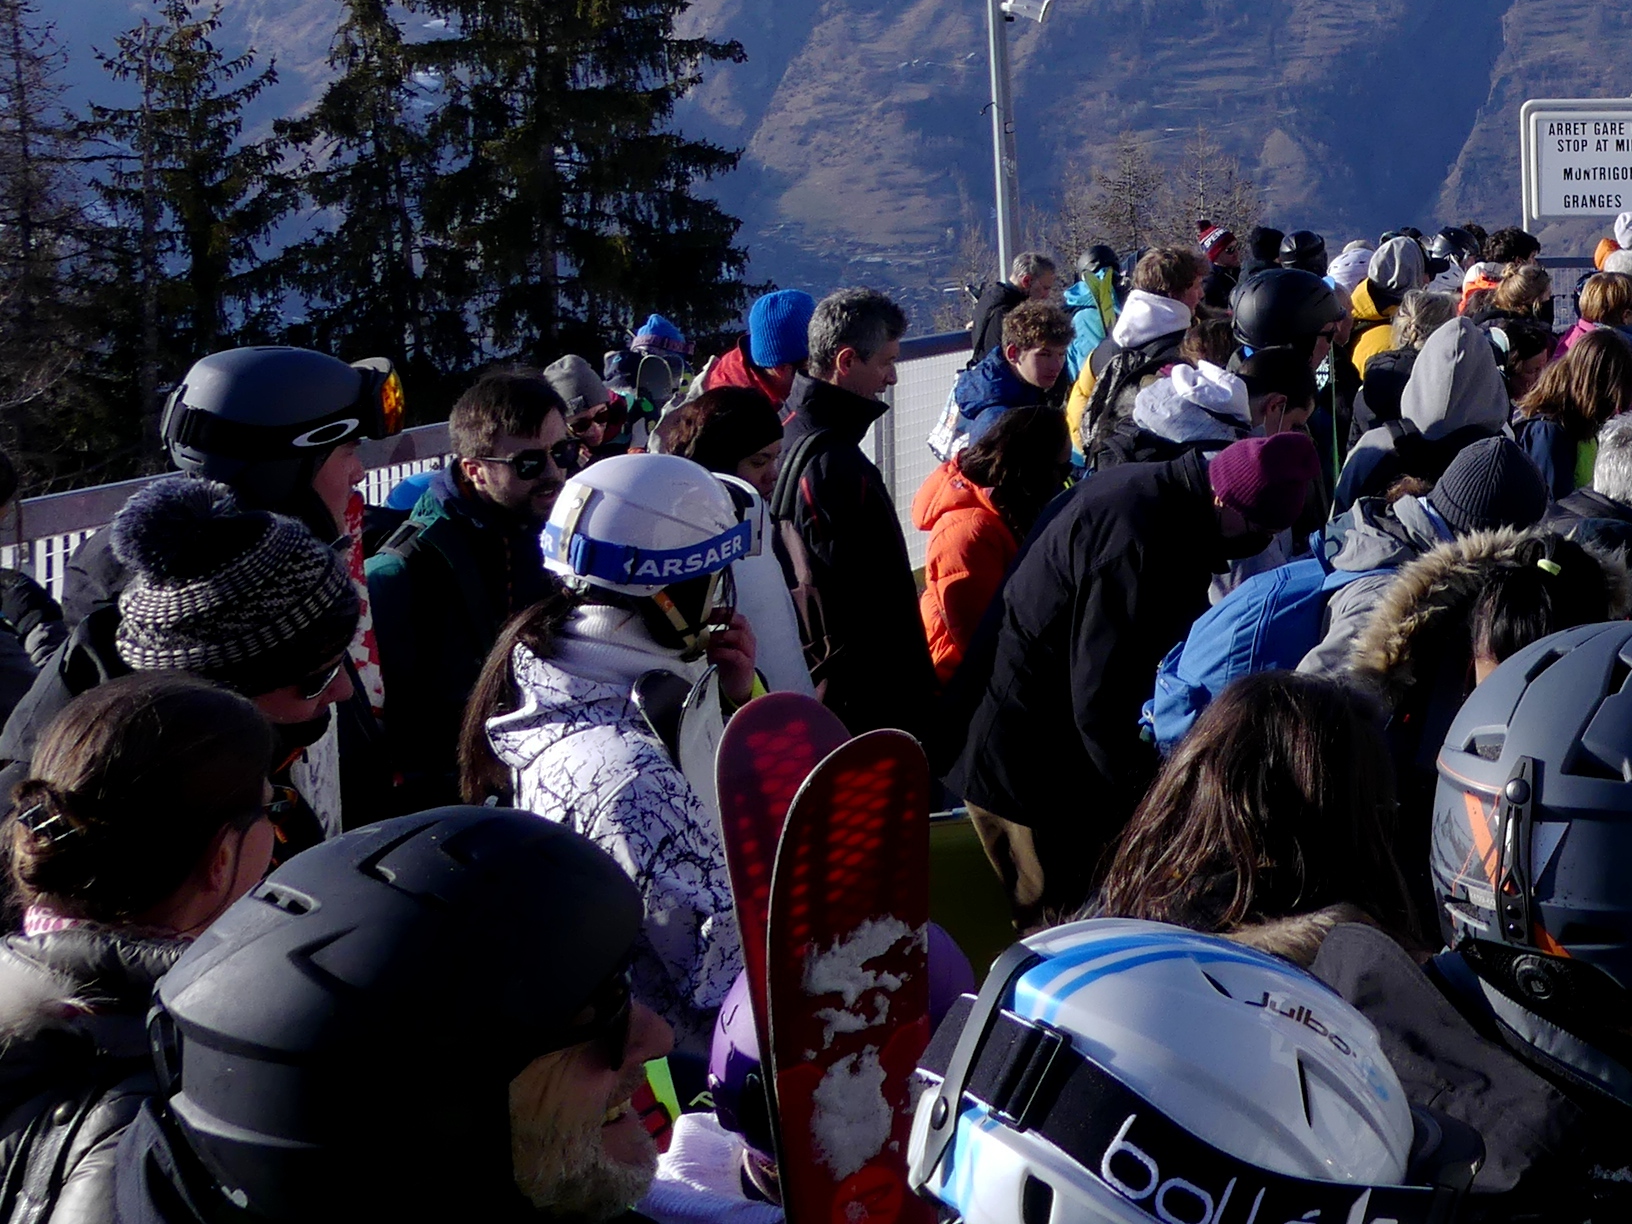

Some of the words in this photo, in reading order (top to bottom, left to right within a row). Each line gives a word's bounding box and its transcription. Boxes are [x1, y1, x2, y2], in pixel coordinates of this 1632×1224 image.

[1548, 123, 1587, 136] ARRET
[1594, 122, 1625, 136] GARE
[1557, 139, 1588, 152] STOP
[1595, 139, 1609, 152] AT
[1563, 194, 1622, 208] GRANGES
[1244, 991, 1353, 1057] Julbo
